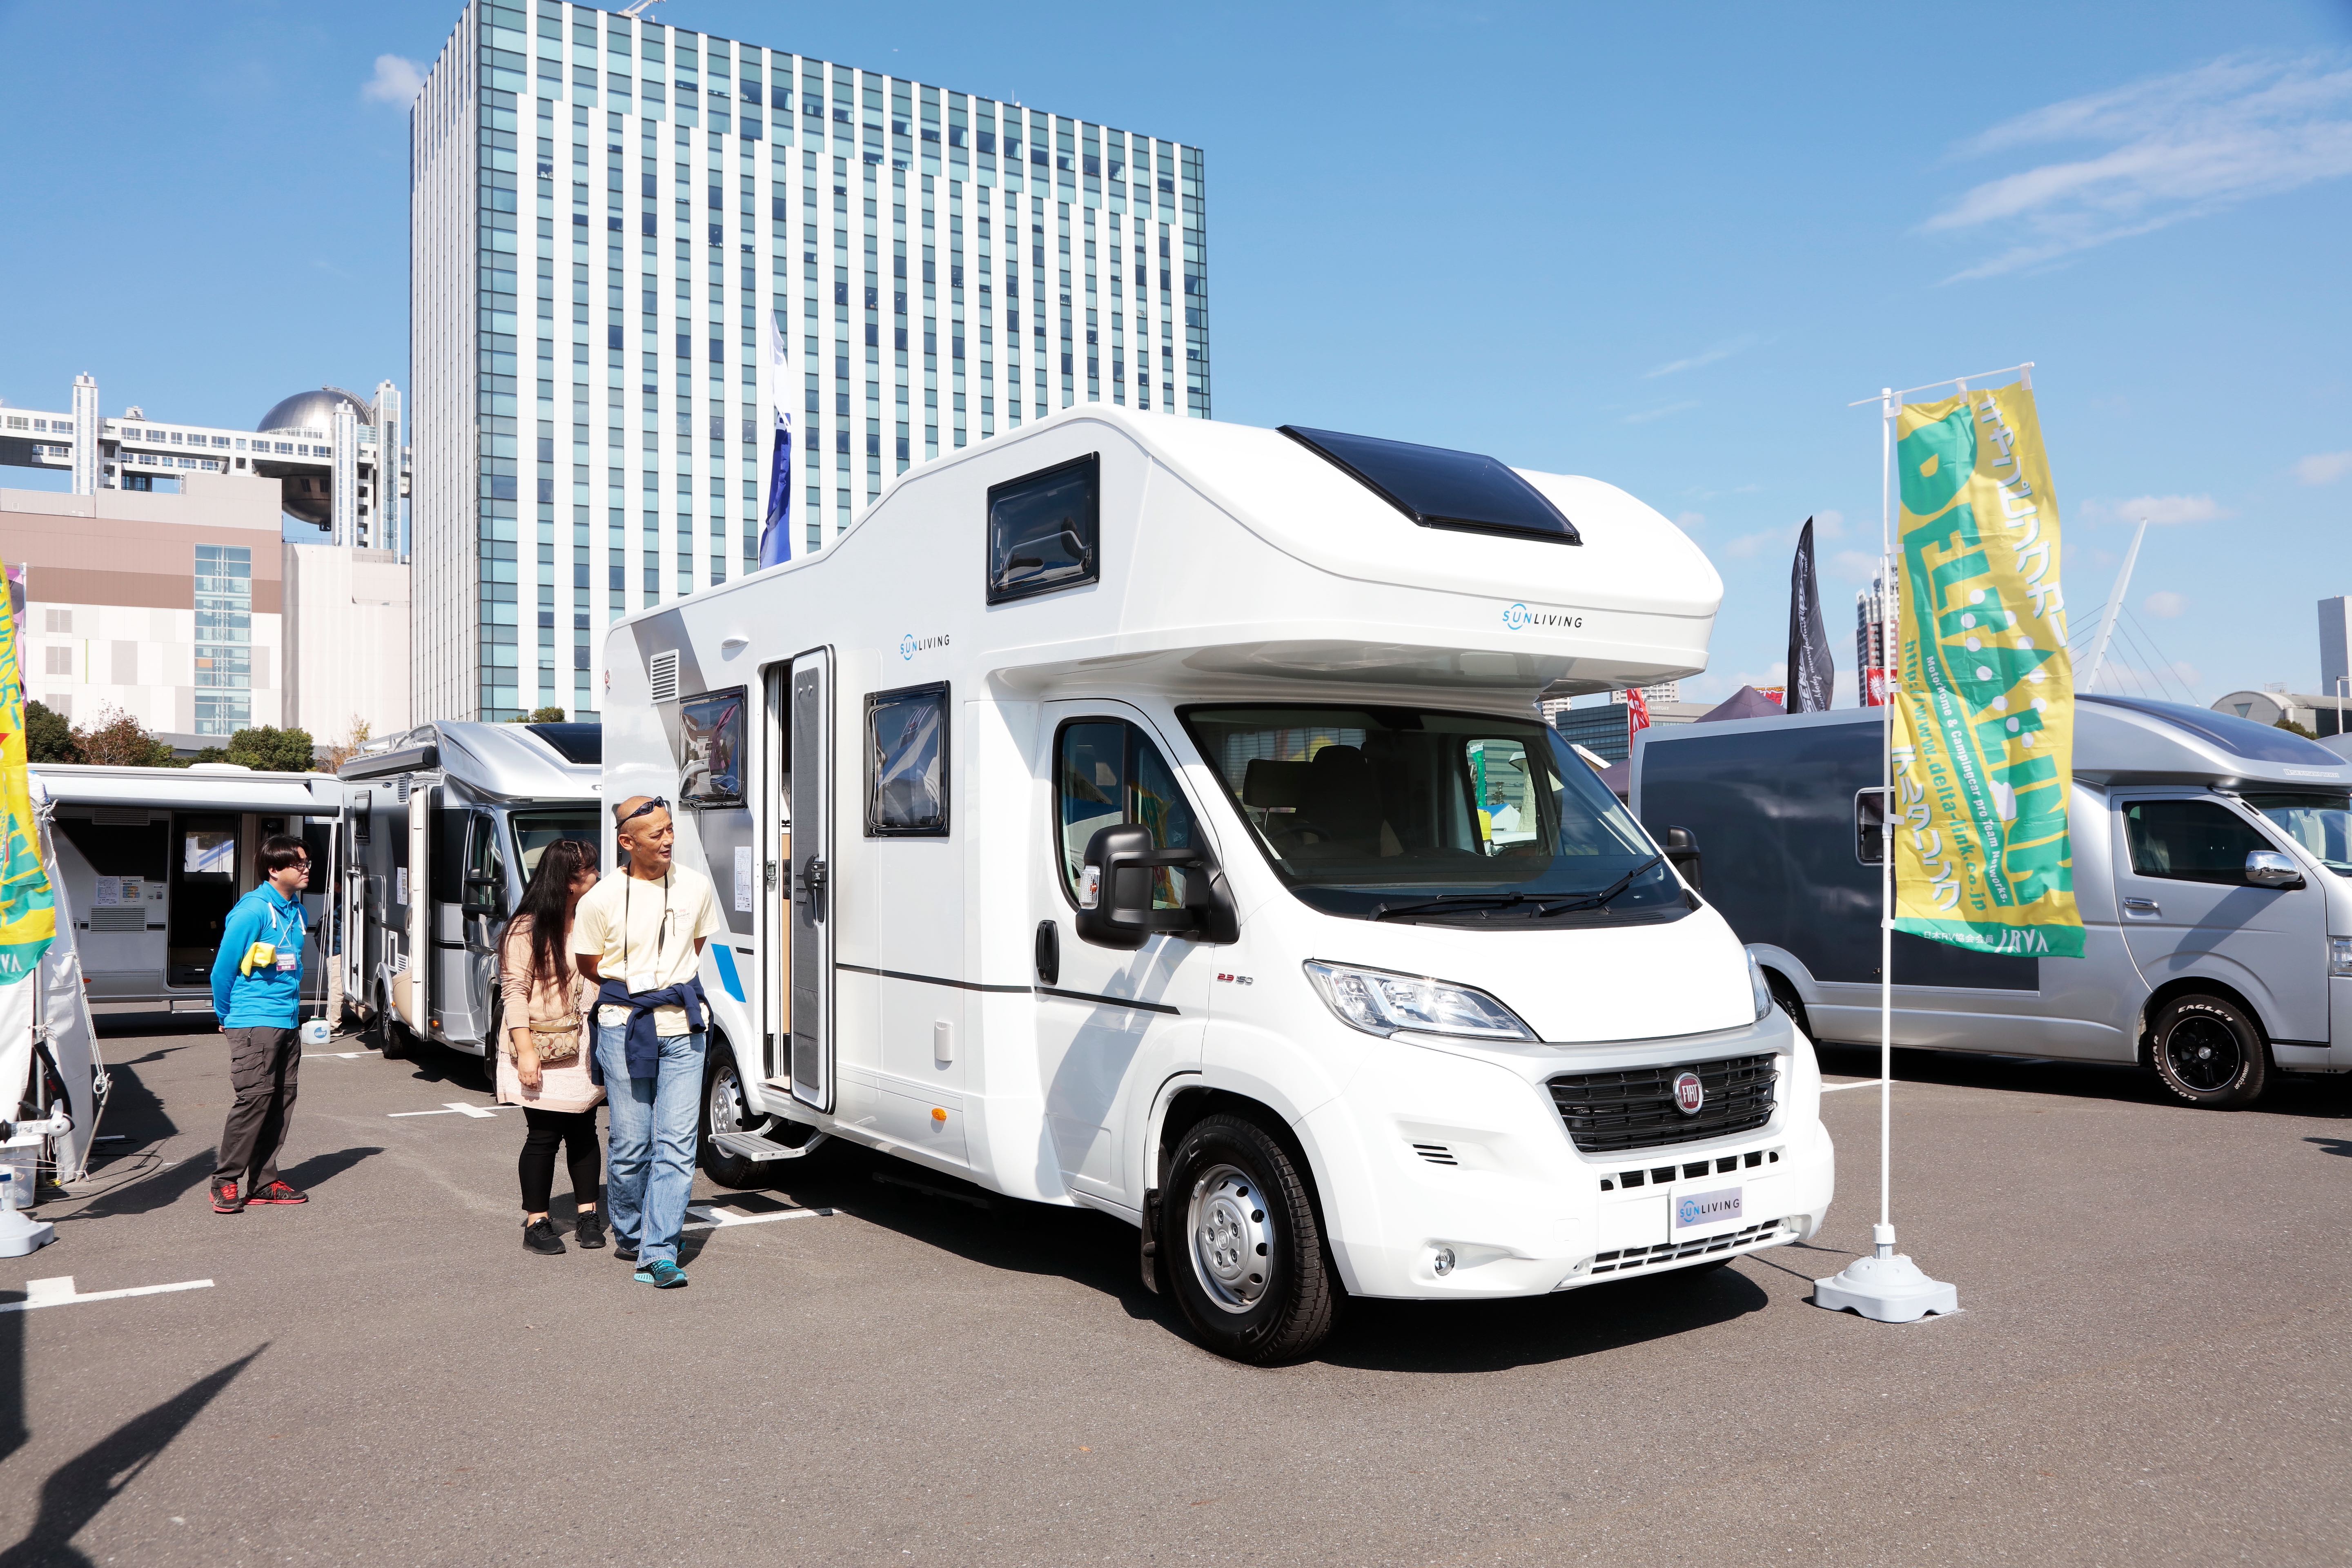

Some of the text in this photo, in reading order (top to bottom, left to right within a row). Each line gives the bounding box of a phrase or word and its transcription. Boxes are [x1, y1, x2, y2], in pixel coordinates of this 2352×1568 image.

[1978, 394, 2068, 648] キャンピングカー
[1502, 610, 1582, 628] SUNLIVING
[900, 634, 950, 655] SUNLIVING
[1904, 640, 1986, 911] http://www.delta-link.co.jp
[1927, 655, 2007, 902] Motorhome & Campingcar pro Team Networks.
[1891, 744, 1961, 912] デルタリンク
[1924, 931, 1994, 944] 日本RV協会会員
[0, 953, 22, 973] VA
[2178, 1004, 2225, 1016] EAGLE
[2153, 1035, 2197, 1101] GOODYEAR
[2234, 1071, 2248, 1090] NASCAR
[1682, 1084, 1697, 1103] FIAT
[1680, 1198, 1740, 1218] SUNLIVING
